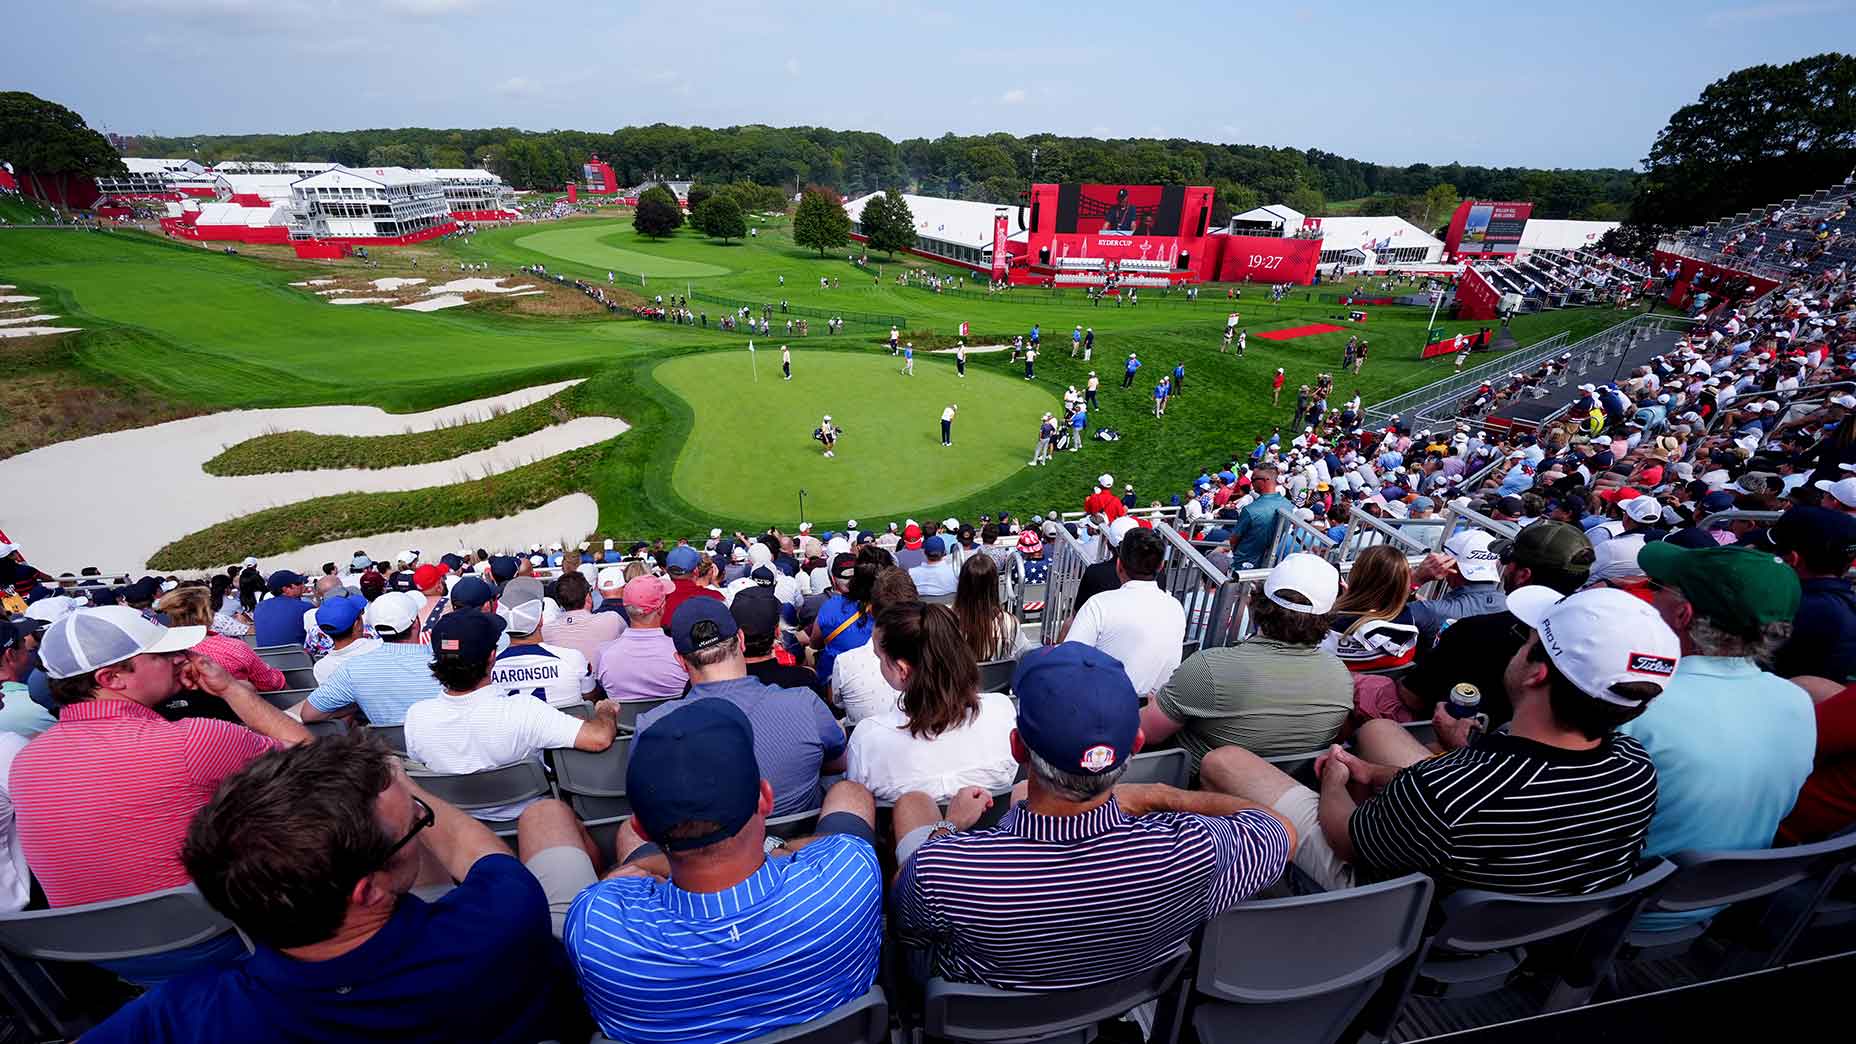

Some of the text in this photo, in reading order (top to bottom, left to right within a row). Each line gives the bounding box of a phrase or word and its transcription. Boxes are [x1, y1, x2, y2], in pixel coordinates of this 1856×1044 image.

[1248, 254, 1283, 269] 19:27
[1542, 618, 1563, 656] PRO V1
[491, 665, 559, 683] AARONSON
